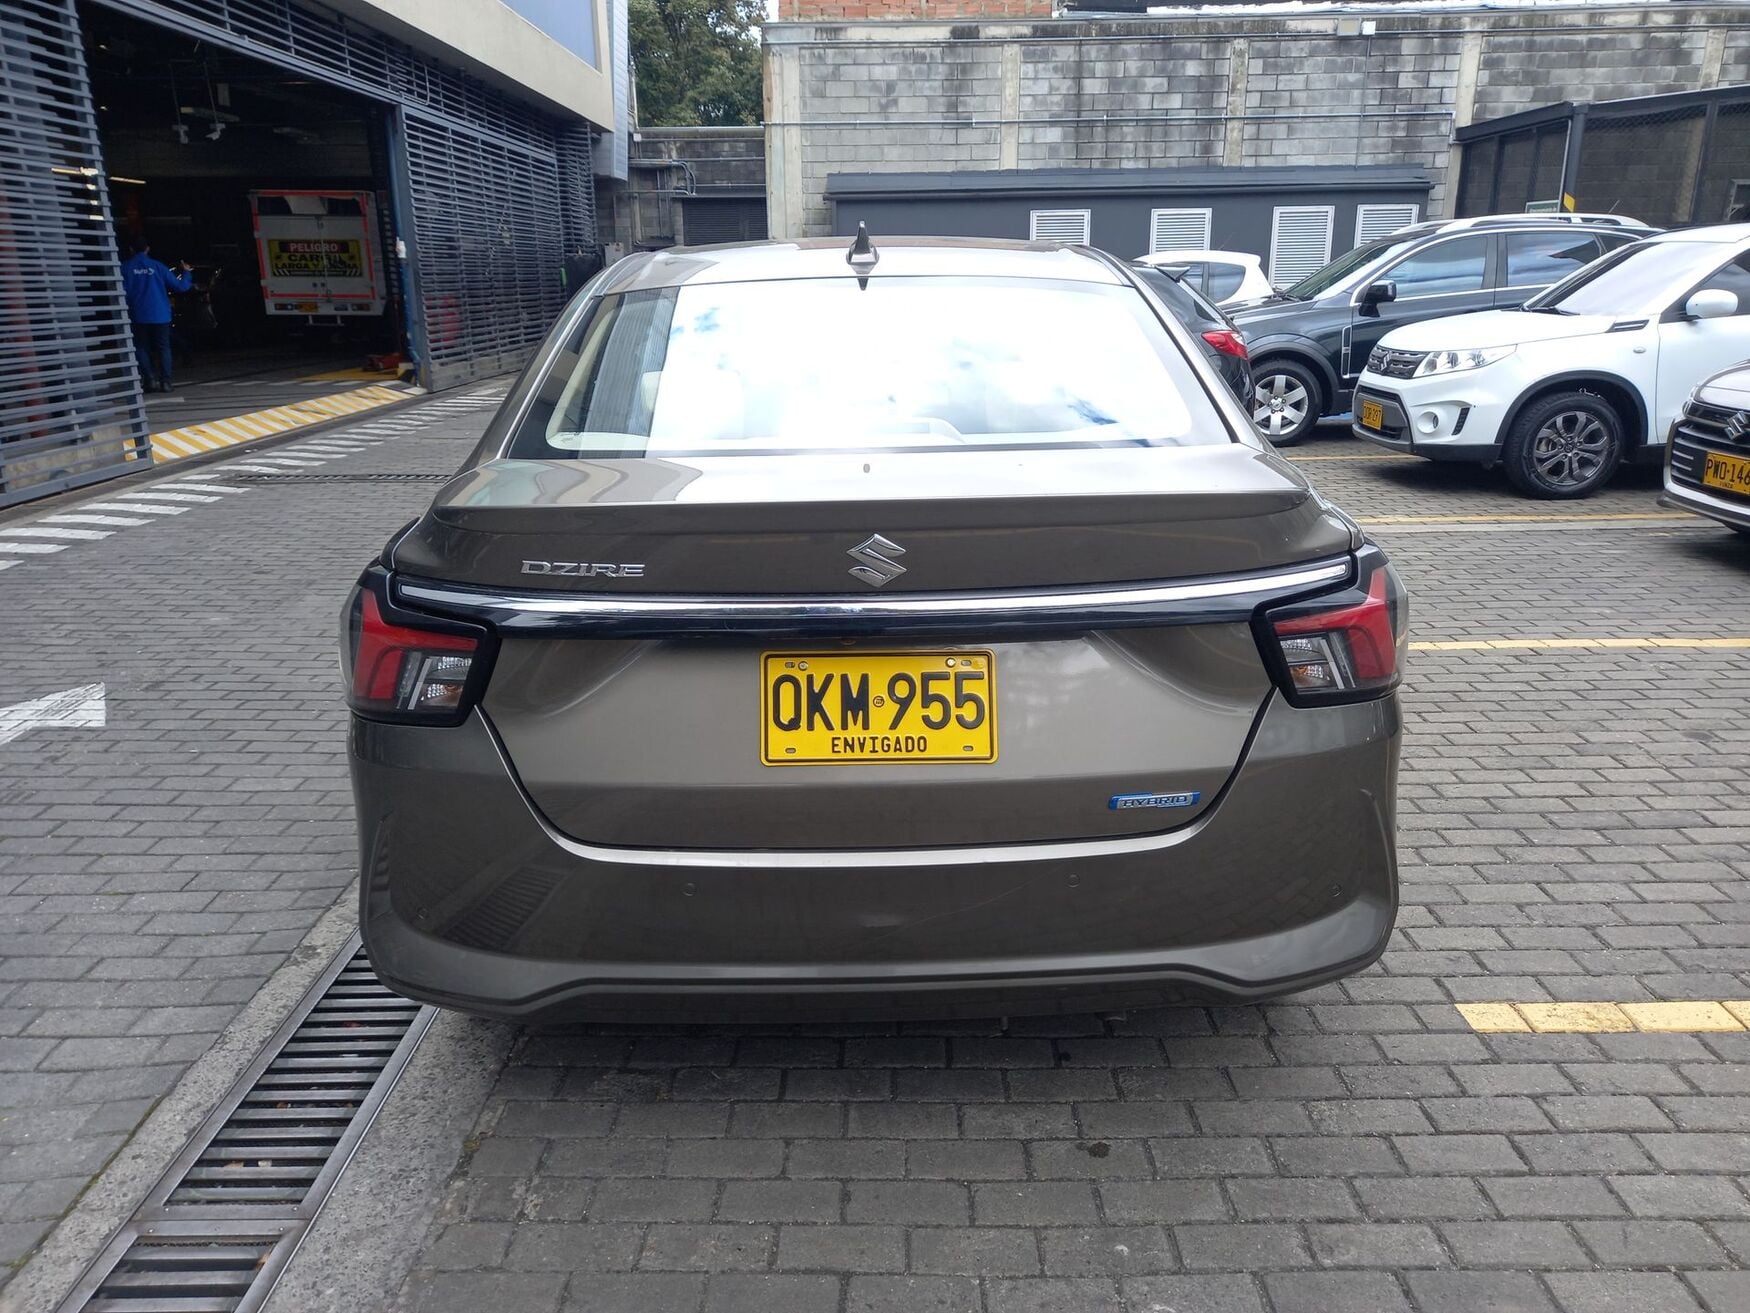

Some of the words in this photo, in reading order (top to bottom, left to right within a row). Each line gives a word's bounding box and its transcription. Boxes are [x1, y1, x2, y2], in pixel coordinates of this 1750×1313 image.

[289, 243, 338, 252] PELIGRO
[521, 560, 646, 578] DZIRE
[831, 736, 928, 754] ENVIGADO
[1121, 796, 1189, 808] HYBRID
